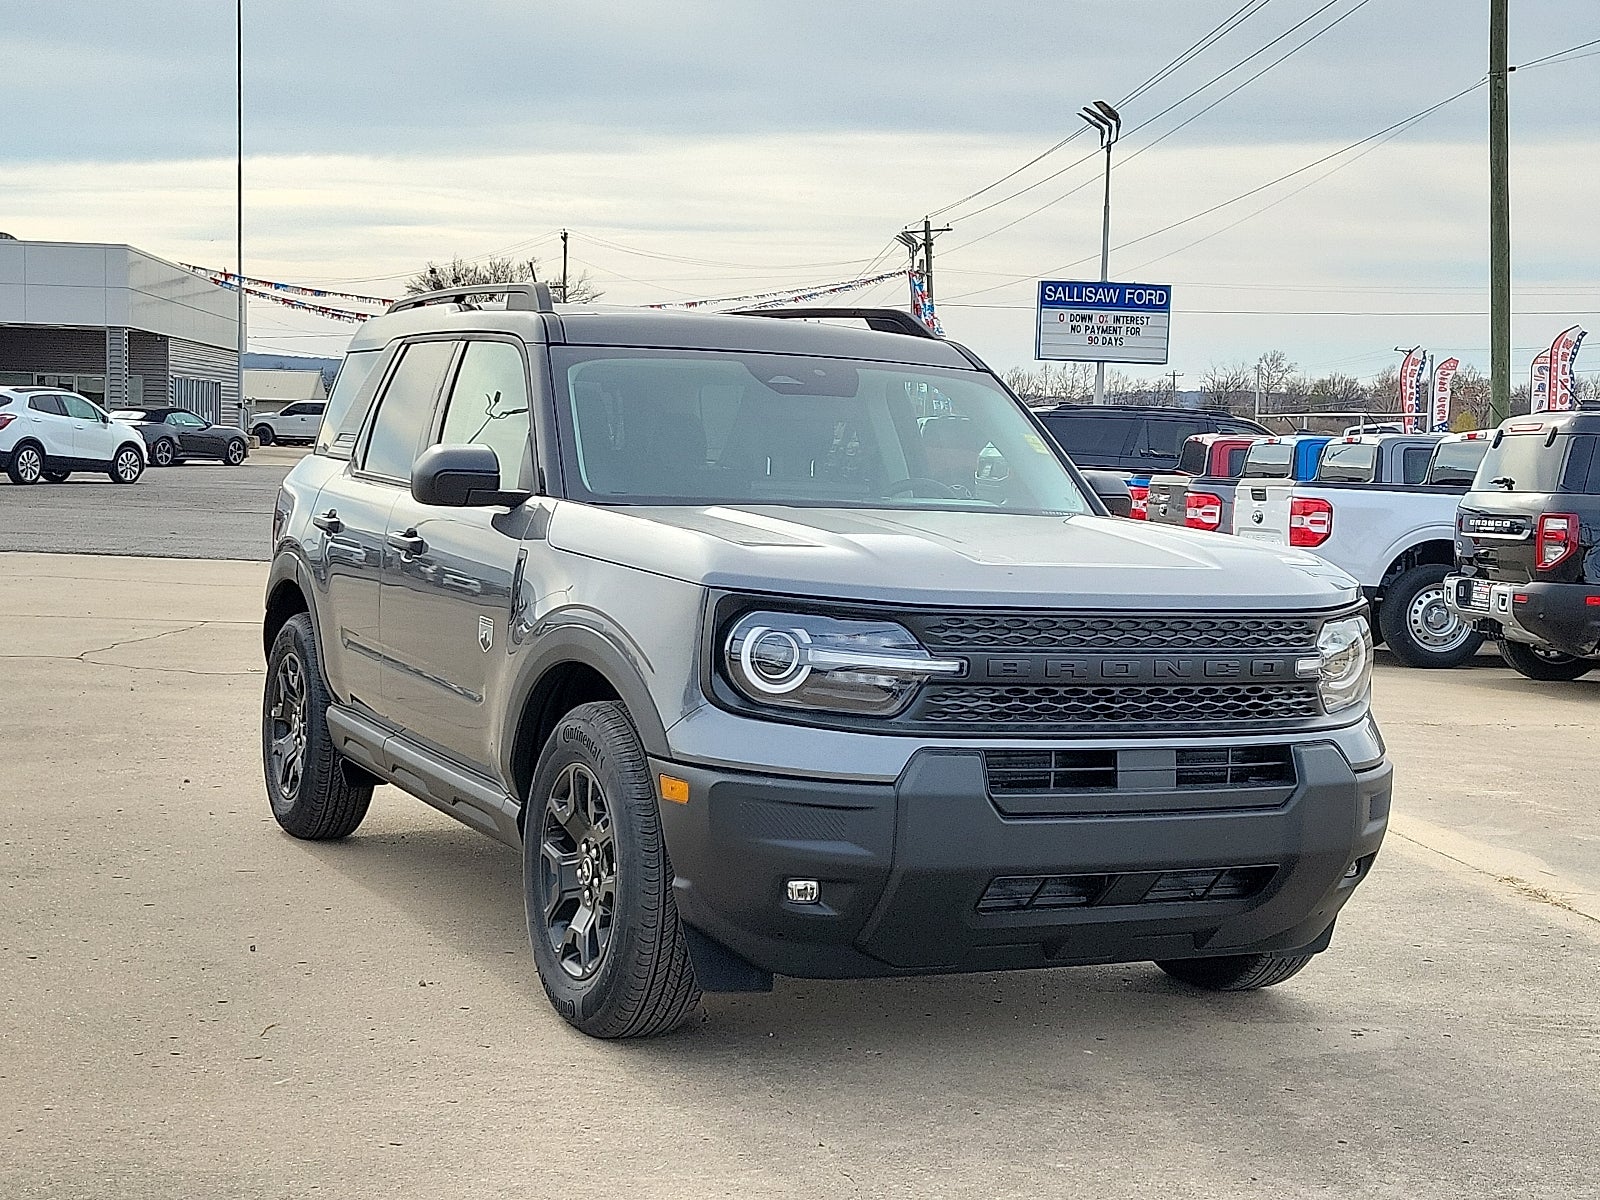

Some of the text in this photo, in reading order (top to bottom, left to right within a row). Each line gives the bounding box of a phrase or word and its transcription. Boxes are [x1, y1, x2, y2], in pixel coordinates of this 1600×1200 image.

[1044, 285, 1167, 305] SALLISAW FORD
[1069, 313, 1094, 323] DOWN
[1113, 315, 1151, 326] INTEREST
[1070, 324, 1141, 336] NO PAYMENT FOR
[1088, 336, 1124, 346] 90 DAYS
[1469, 519, 1511, 528] BRONCO
[987, 657, 1286, 678] BRONCO
[563, 724, 602, 761] Continental
